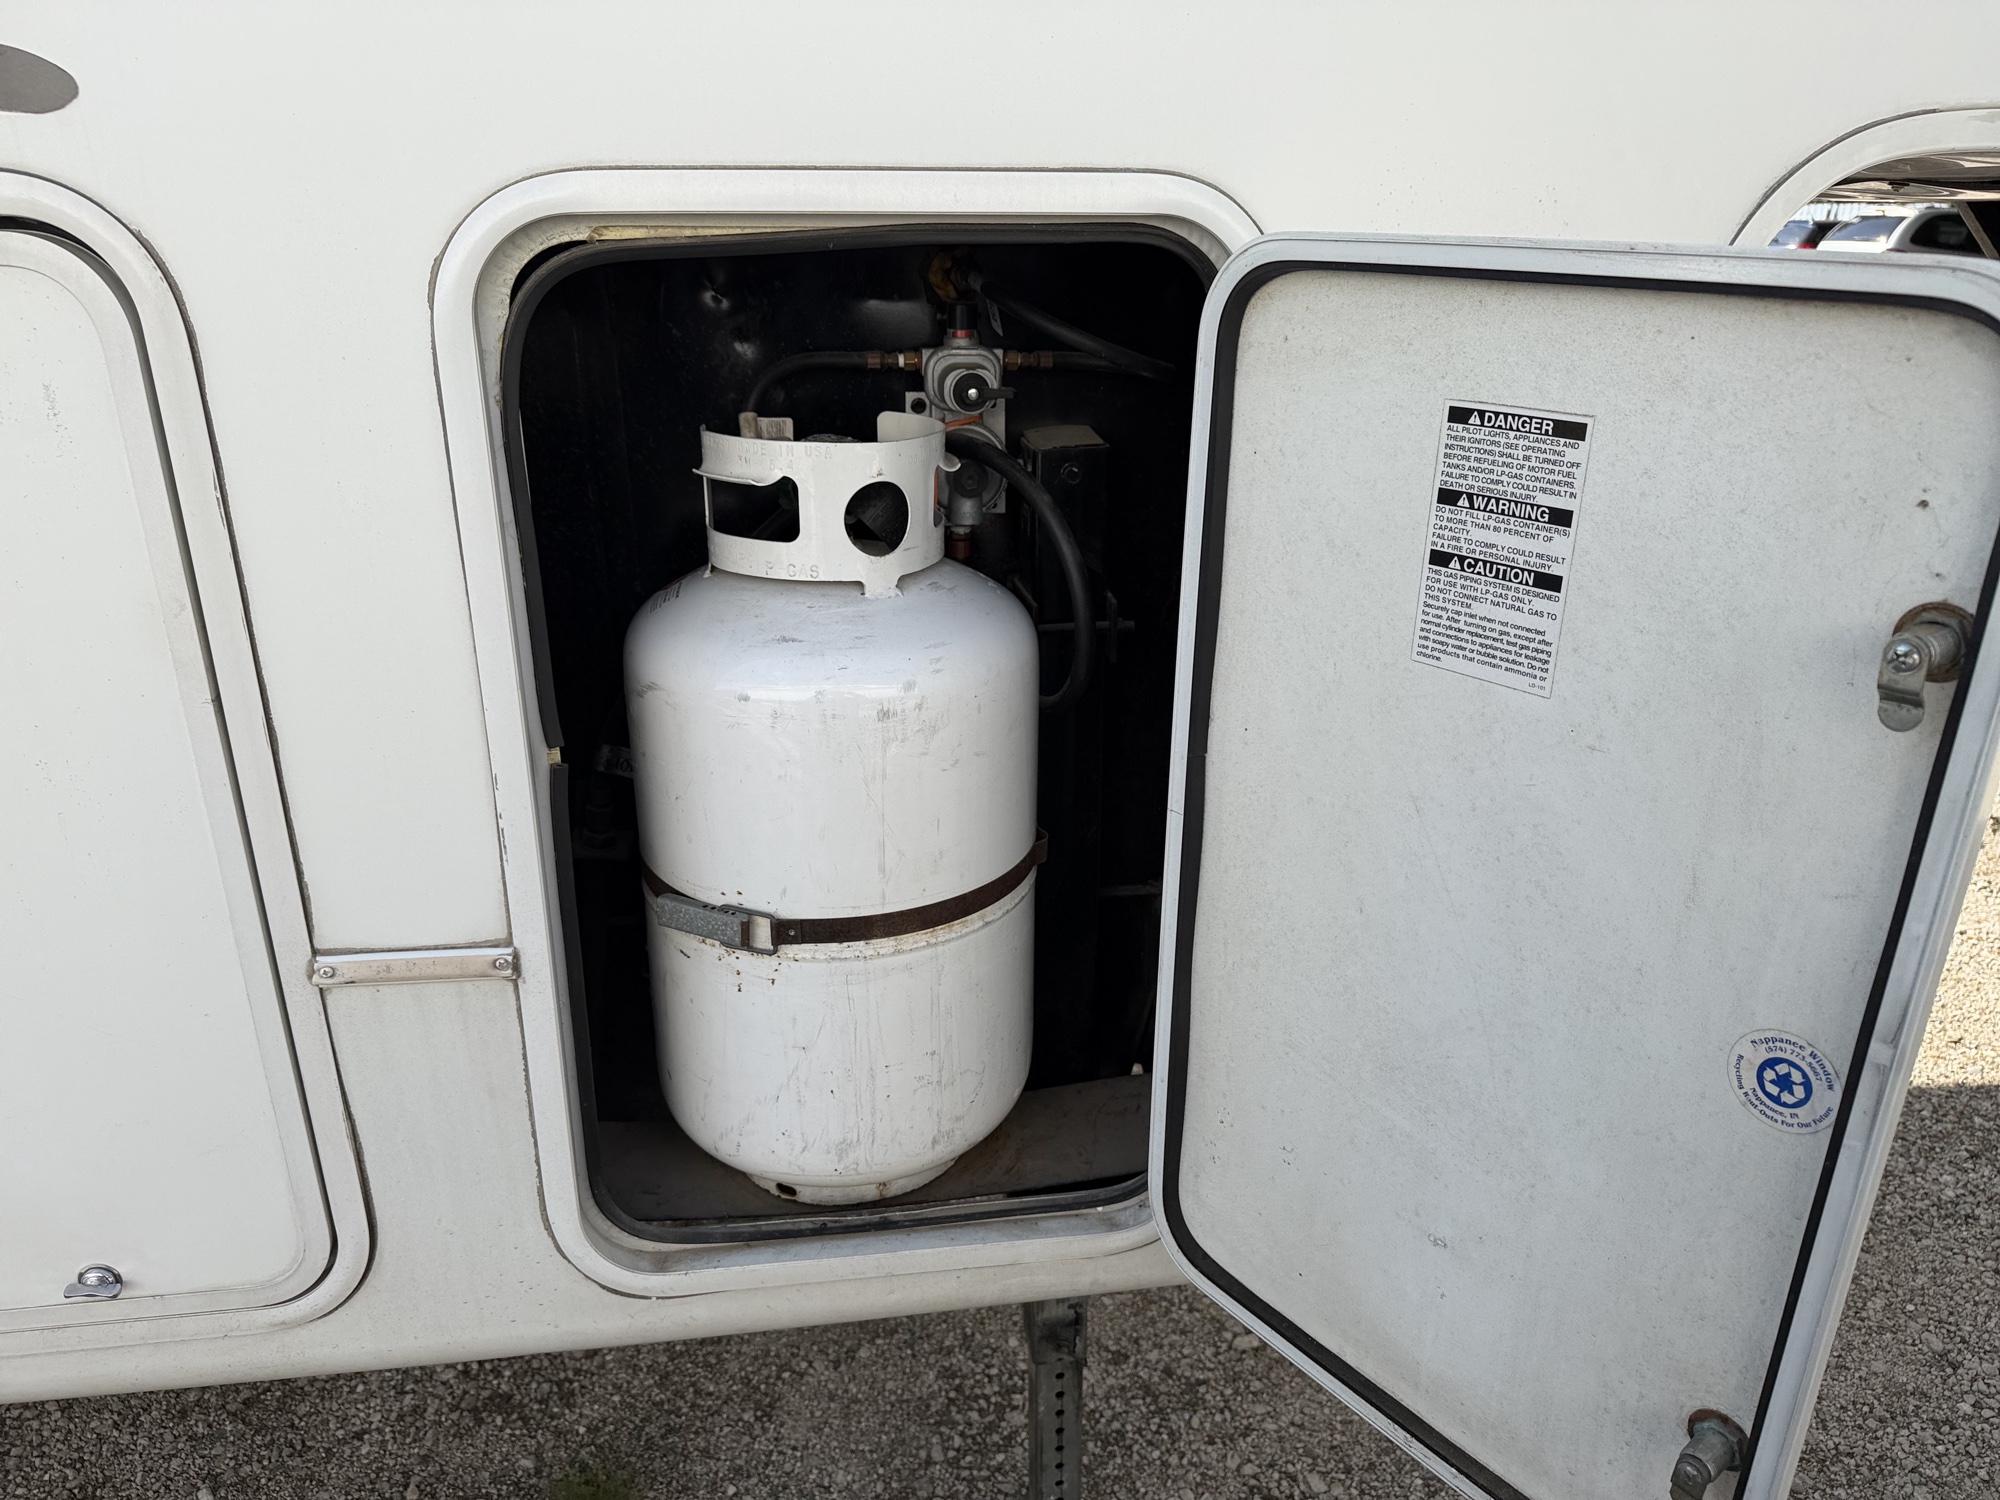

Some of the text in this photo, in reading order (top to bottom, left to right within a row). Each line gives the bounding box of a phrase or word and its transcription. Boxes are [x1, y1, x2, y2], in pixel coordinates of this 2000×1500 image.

[1447, 424, 1579, 449] ALL PILOT LIGHTS, APPLIANCES AND
[1483, 412, 1554, 435] DANGER
[736, 440, 767, 456] MADE
[779, 443, 795, 457] IN
[804, 445, 833, 460] USA
[1444, 443, 1581, 470] INSTRUCTIONS) SHALL BE TURNED OFF
[1446, 434, 1566, 457] THEIR IGNITORS (SEE OPERATING
[1442, 461, 1576, 489] TANKS AND/OR LP-GAS CONTAINERS.
[1443, 452, 1577, 479] BEFORE REFUELING OF MOTOR FUEL
[1440, 479, 1539, 502] DEATH OR SERIOUS INJURY.
[1441, 470, 1577, 499] FAILURE TO COMPLY COULD RESULT IN
[1435, 505, 1571, 538] DO NOT FILL LP-GAS CONTAINER(S)
[1472, 495, 1550, 522] WARNING
[1433, 523, 1472, 537] CAPACITY.
[1434, 514, 1554, 543] TO MORE THAN 80 PERCENT OF
[1432, 532, 1565, 565] FAILURE TO COMPLY COULD RESULT
[1447, 543, 1463, 553] FIRE
[1465, 547, 1477, 556] OR
[1478, 550, 1521, 565] PERSONAL
[1522, 559, 1554, 572] INJURY.
[1427, 567, 1560, 603] THIS GAS PIPING SYSTEM IS DESIGNED
[1463, 558, 1534, 586] CAUTION
[1424, 592, 1473, 610] THIS SYSTEM.
[1425, 584, 1557, 621] DO NOT CONNECT NATURAL GAS TO
[1426, 576, 1535, 606] FOR USE WITH LP-GAS ONLY.
[1422, 609, 1430, 617] for
[1446, 615, 1461, 624] After
[1463, 619, 1486, 632] turning
[1498, 629, 1512, 639] gas,
[1513, 632, 1536, 645] except
[1537, 638, 1553, 647] after
[1423, 601, 1546, 637] Securely cap inlet when not connected
[1420, 626, 1431, 634] and
[1432, 629, 1469, 644] connections
[1478, 641, 1513, 657] appliances
[1514, 650, 1523, 658] for
[1524, 653, 1550, 666] leakage
[1421, 617, 1552, 658] normal cylinder replacement, test gas piping
[1416, 650, 1442, 662] chlorine.
[1418, 634, 1431, 642] with
[1431, 639, 1450, 649] soapy
[1451, 642, 1467, 652] water
[1476, 649, 1498, 660] bubble
[1498, 655, 1526, 667] solution.
[1527, 662, 1537, 670] Do
[1538, 665, 1549, 673] not
[1430, 645, 1460, 660] products
[1462, 654, 1475, 663] that
[1476, 658, 1502, 670] contain
[1504, 665, 1537, 679] ammonia
[1528, 682, 1545, 691] LD-101
[1750, 1036, 1835, 1093] Nappanee Window
[1765, 1045, 1824, 1082] (574) 773-5667
[1733, 1053, 1745, 1090] Recycling
[1780, 1120, 1795, 1128] For
[1796, 1121, 1812, 1129] Our
[1812, 1106, 1834, 1126] Future
